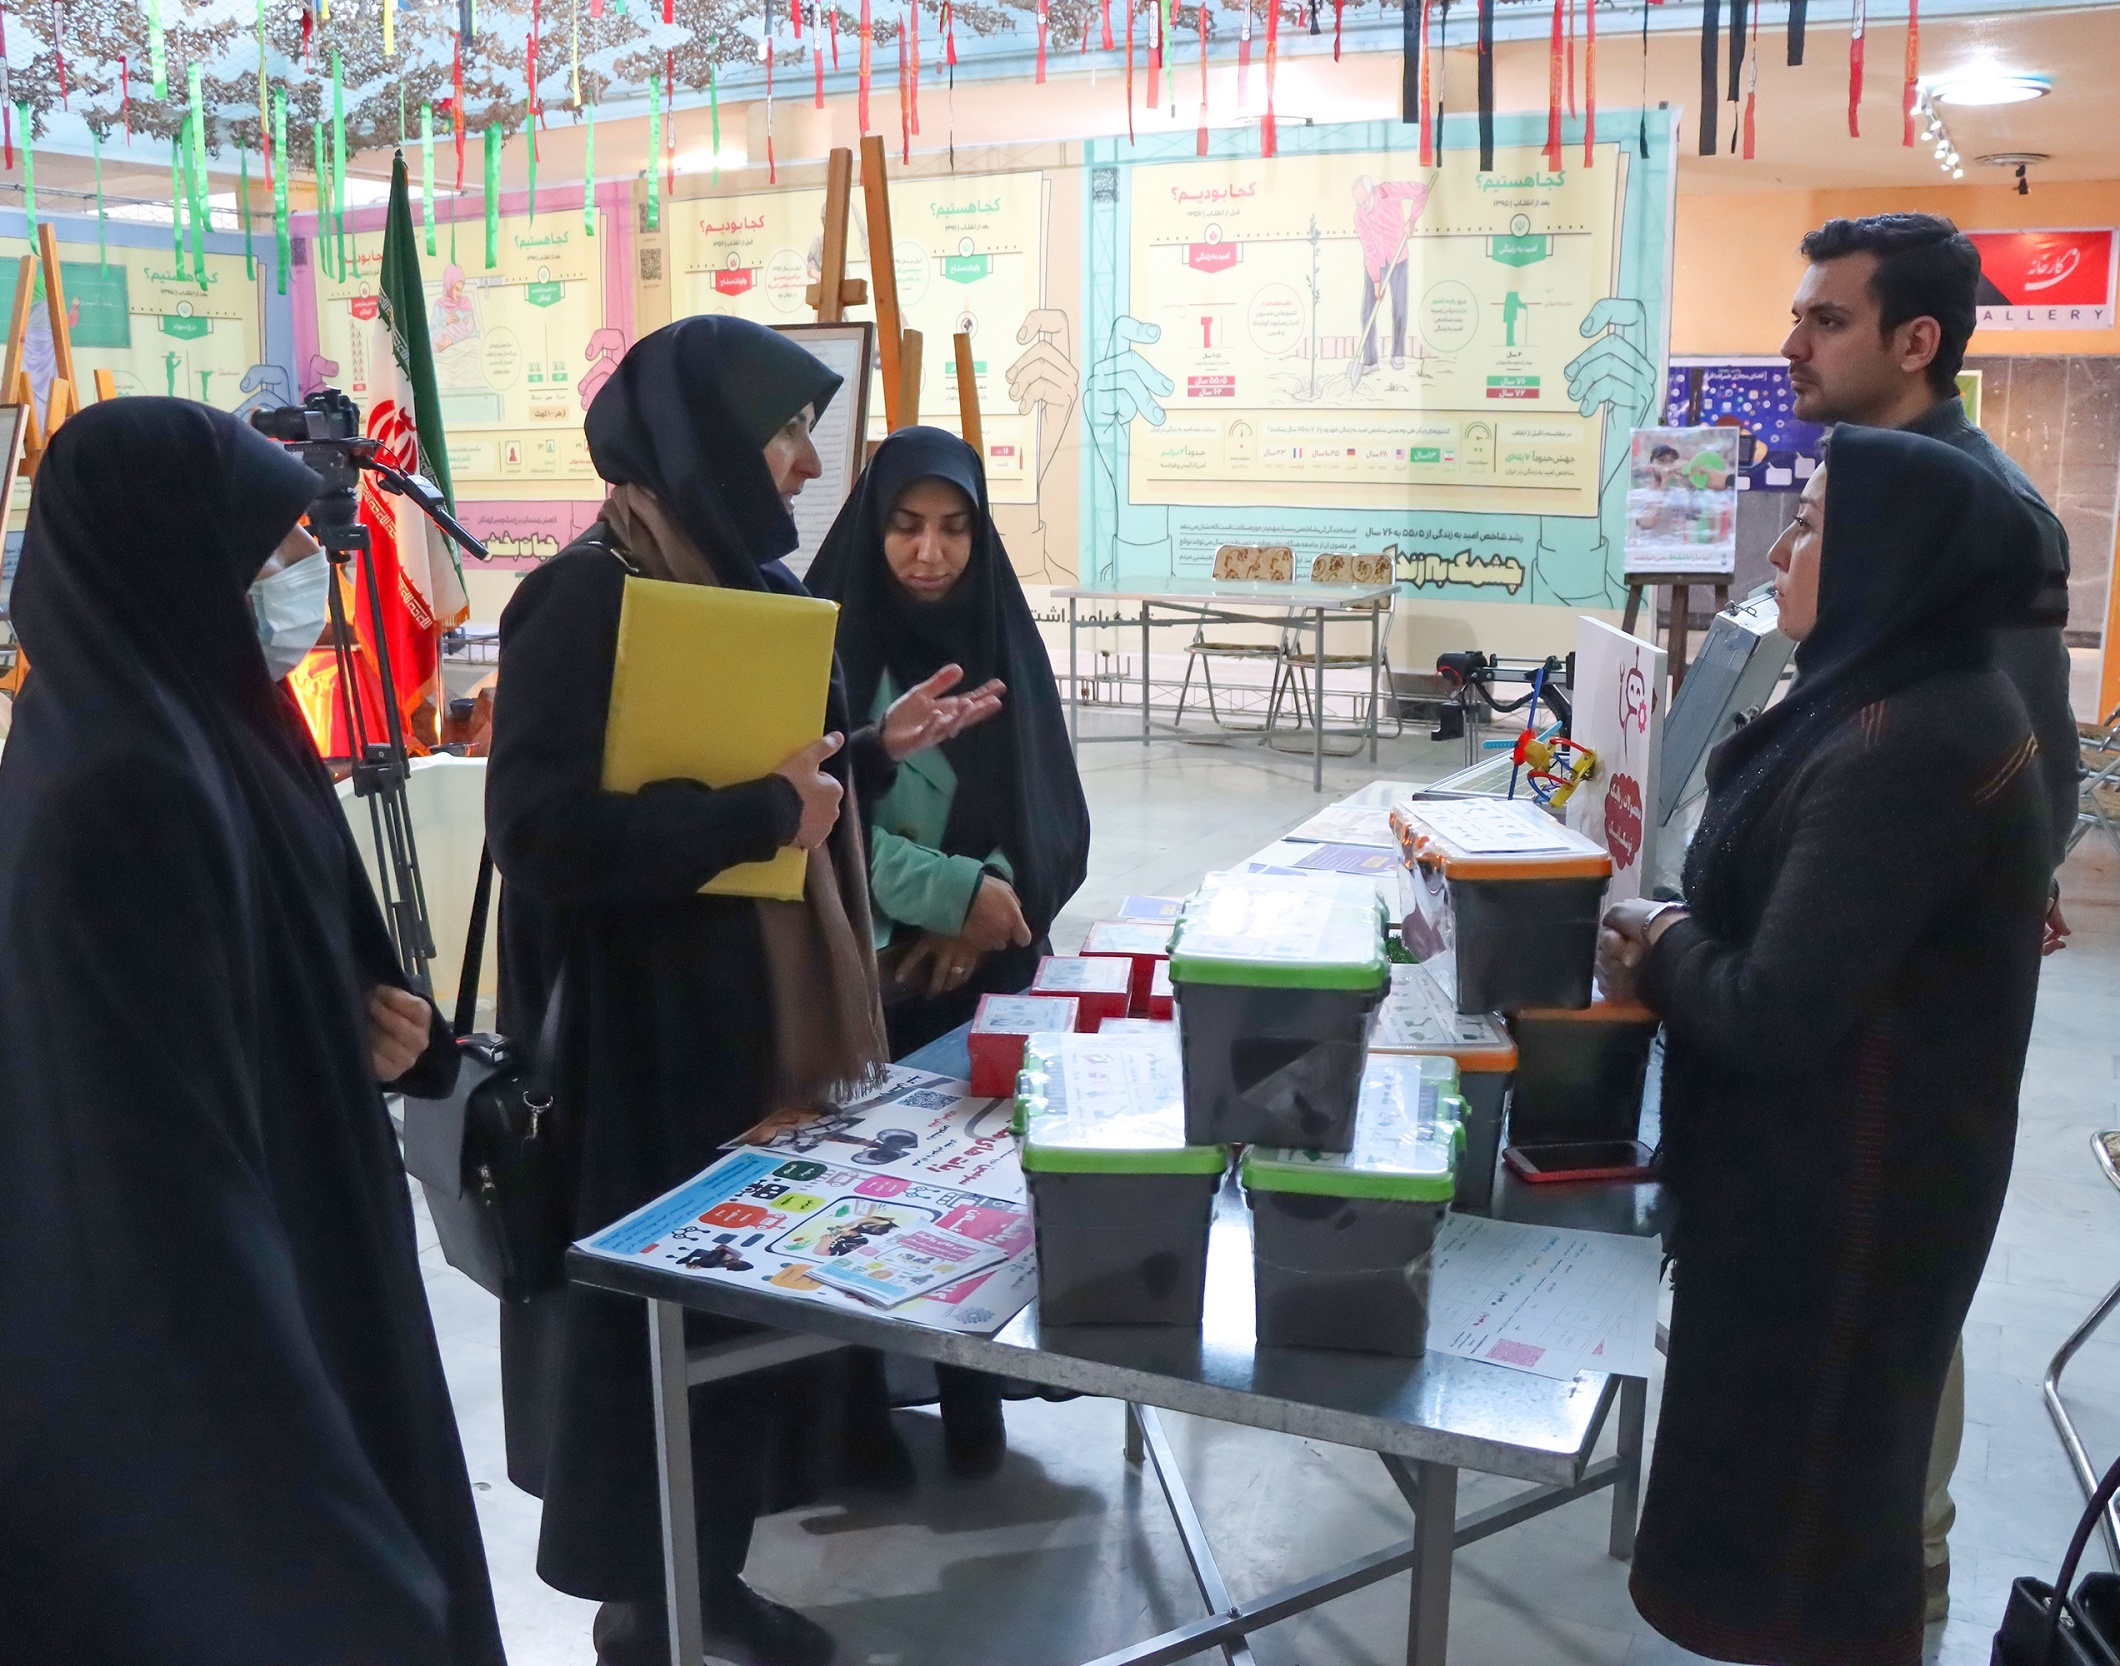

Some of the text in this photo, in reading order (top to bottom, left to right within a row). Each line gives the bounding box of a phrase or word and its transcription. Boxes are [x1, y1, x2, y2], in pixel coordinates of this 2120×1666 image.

[1171, 182, 1257, 204] کجا بودیم؟
[978, 196, 1001, 217] کجا
[700, 215, 765, 236] کجا بودیم؟
[1983, 309, 2103, 321] ALLERY
